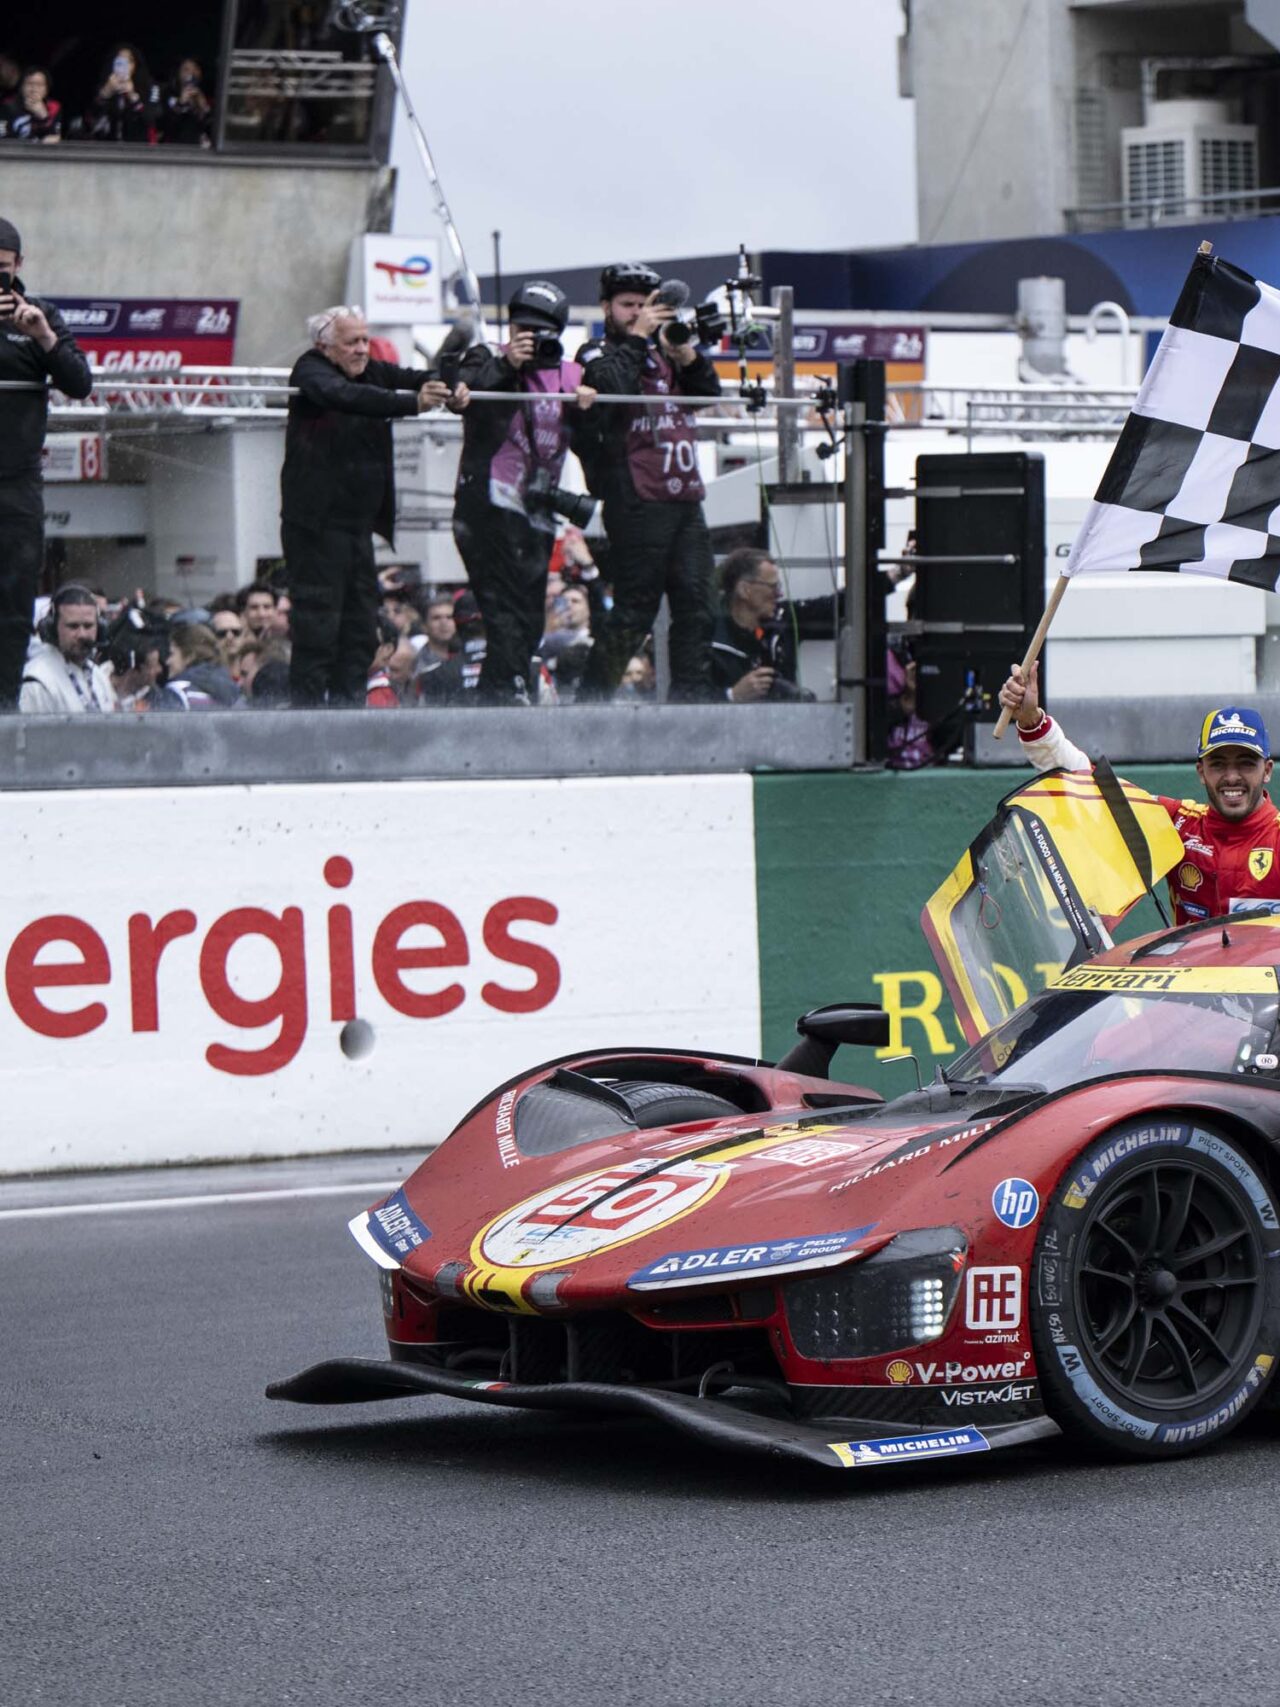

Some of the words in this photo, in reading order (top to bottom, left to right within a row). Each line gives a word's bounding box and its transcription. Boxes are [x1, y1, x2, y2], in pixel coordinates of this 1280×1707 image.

[1210, 726, 1257, 738] MICHELIN
[495, 1088, 518, 1135] RICHARD
[498, 1131, 520, 1169] MILLE
[1092, 1127, 1181, 1177] MICHELIN
[1199, 1134, 1224, 1153] PILOT
[1223, 1148, 1251, 1179] SPORT
[829, 1146, 932, 1193] RICHARD
[538, 1177, 678, 1220] 50
[1000, 1179, 1034, 1227] hp
[650, 1246, 768, 1276] ADLER
[802, 1236, 847, 1248] PELZER
[798, 1245, 842, 1256] GROUP
[984, 1330, 1020, 1344] azimut
[916, 1361, 1026, 1384] V-Power
[941, 1382, 1035, 1406] VISTAJET
[1092, 1396, 1123, 1424] SPORT
[1163, 1386, 1252, 1442] MICHELIN
[879, 1435, 971, 1454] MICHELIN
